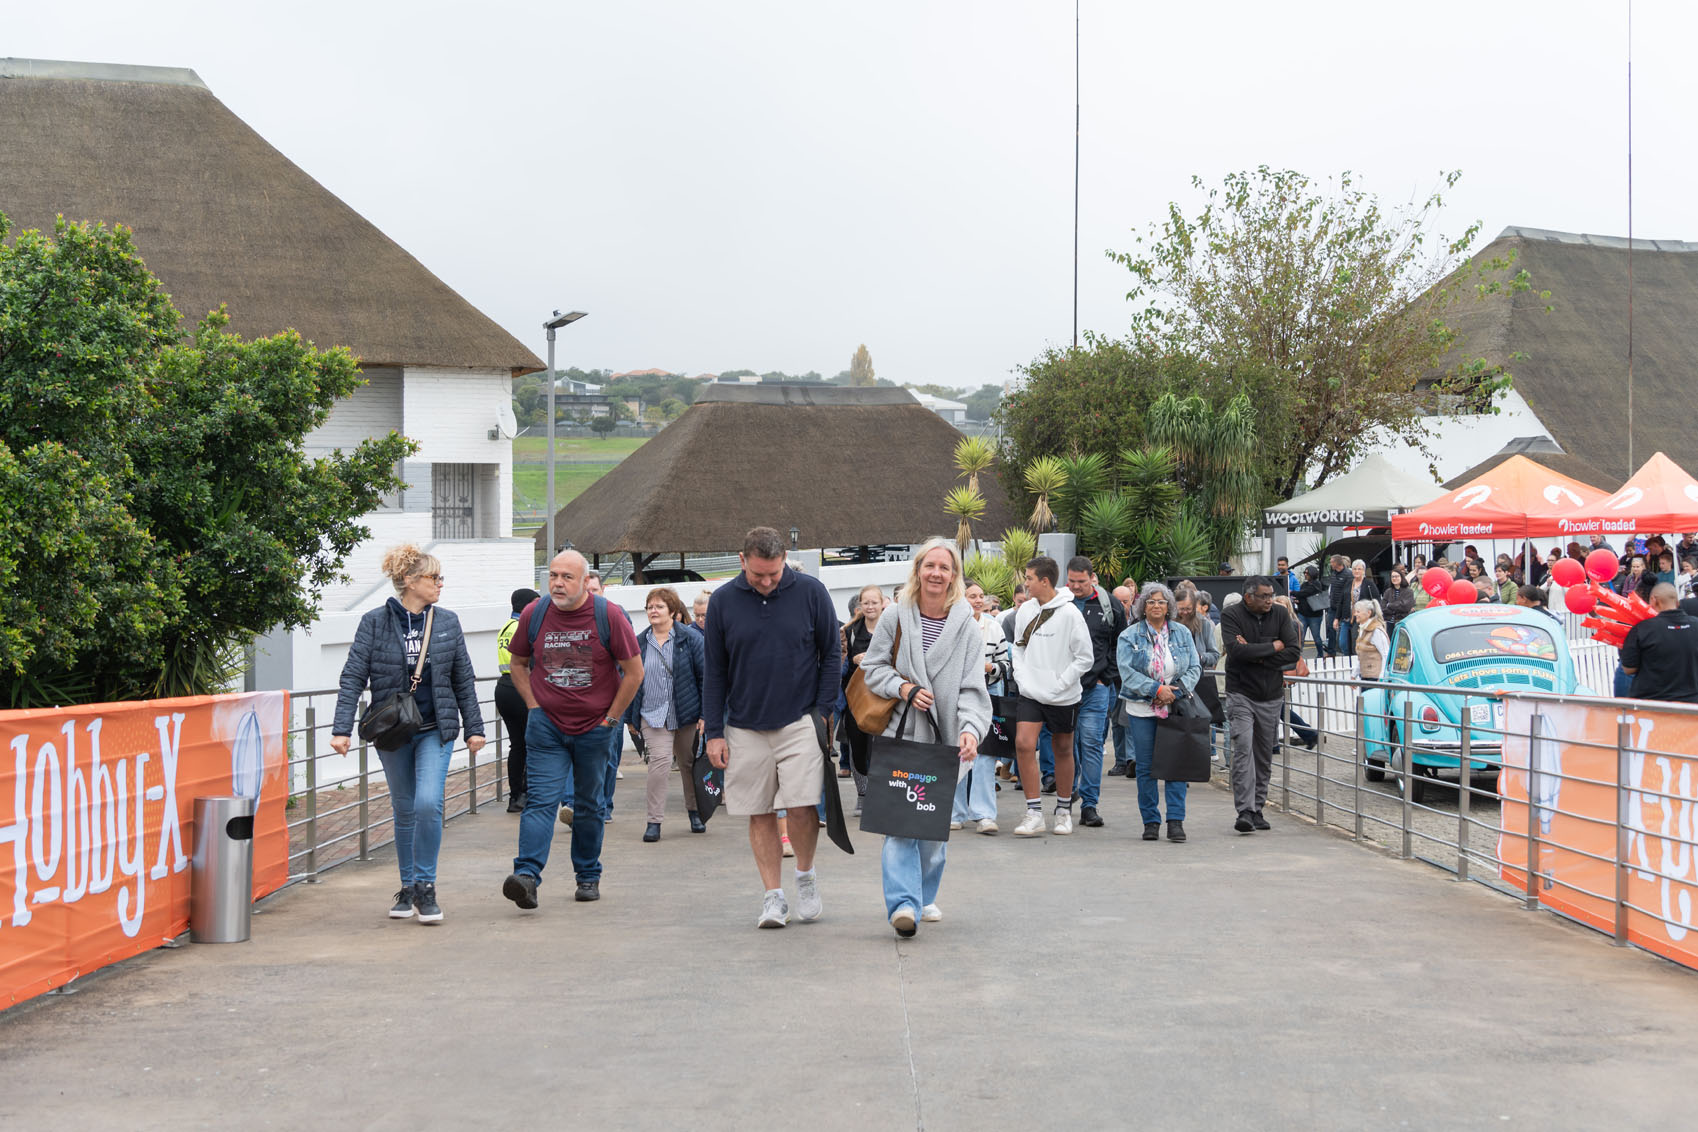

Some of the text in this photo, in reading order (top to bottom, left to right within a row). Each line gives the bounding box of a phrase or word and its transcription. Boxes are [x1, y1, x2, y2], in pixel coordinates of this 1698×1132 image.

[1265, 510, 1364, 525] WOOLWORTHS
[1429, 523, 1493, 535] howler loaded
[1569, 519, 1636, 532] howler loaded
[544, 630, 592, 642] STREET
[1467, 648, 1498, 656] CRAFTS
[1448, 673, 1469, 685] Lets
[1472, 668, 1497, 677] have
[892, 769, 937, 783] shopaygo
[888, 780, 907, 788] with
[916, 802, 936, 811] bob
